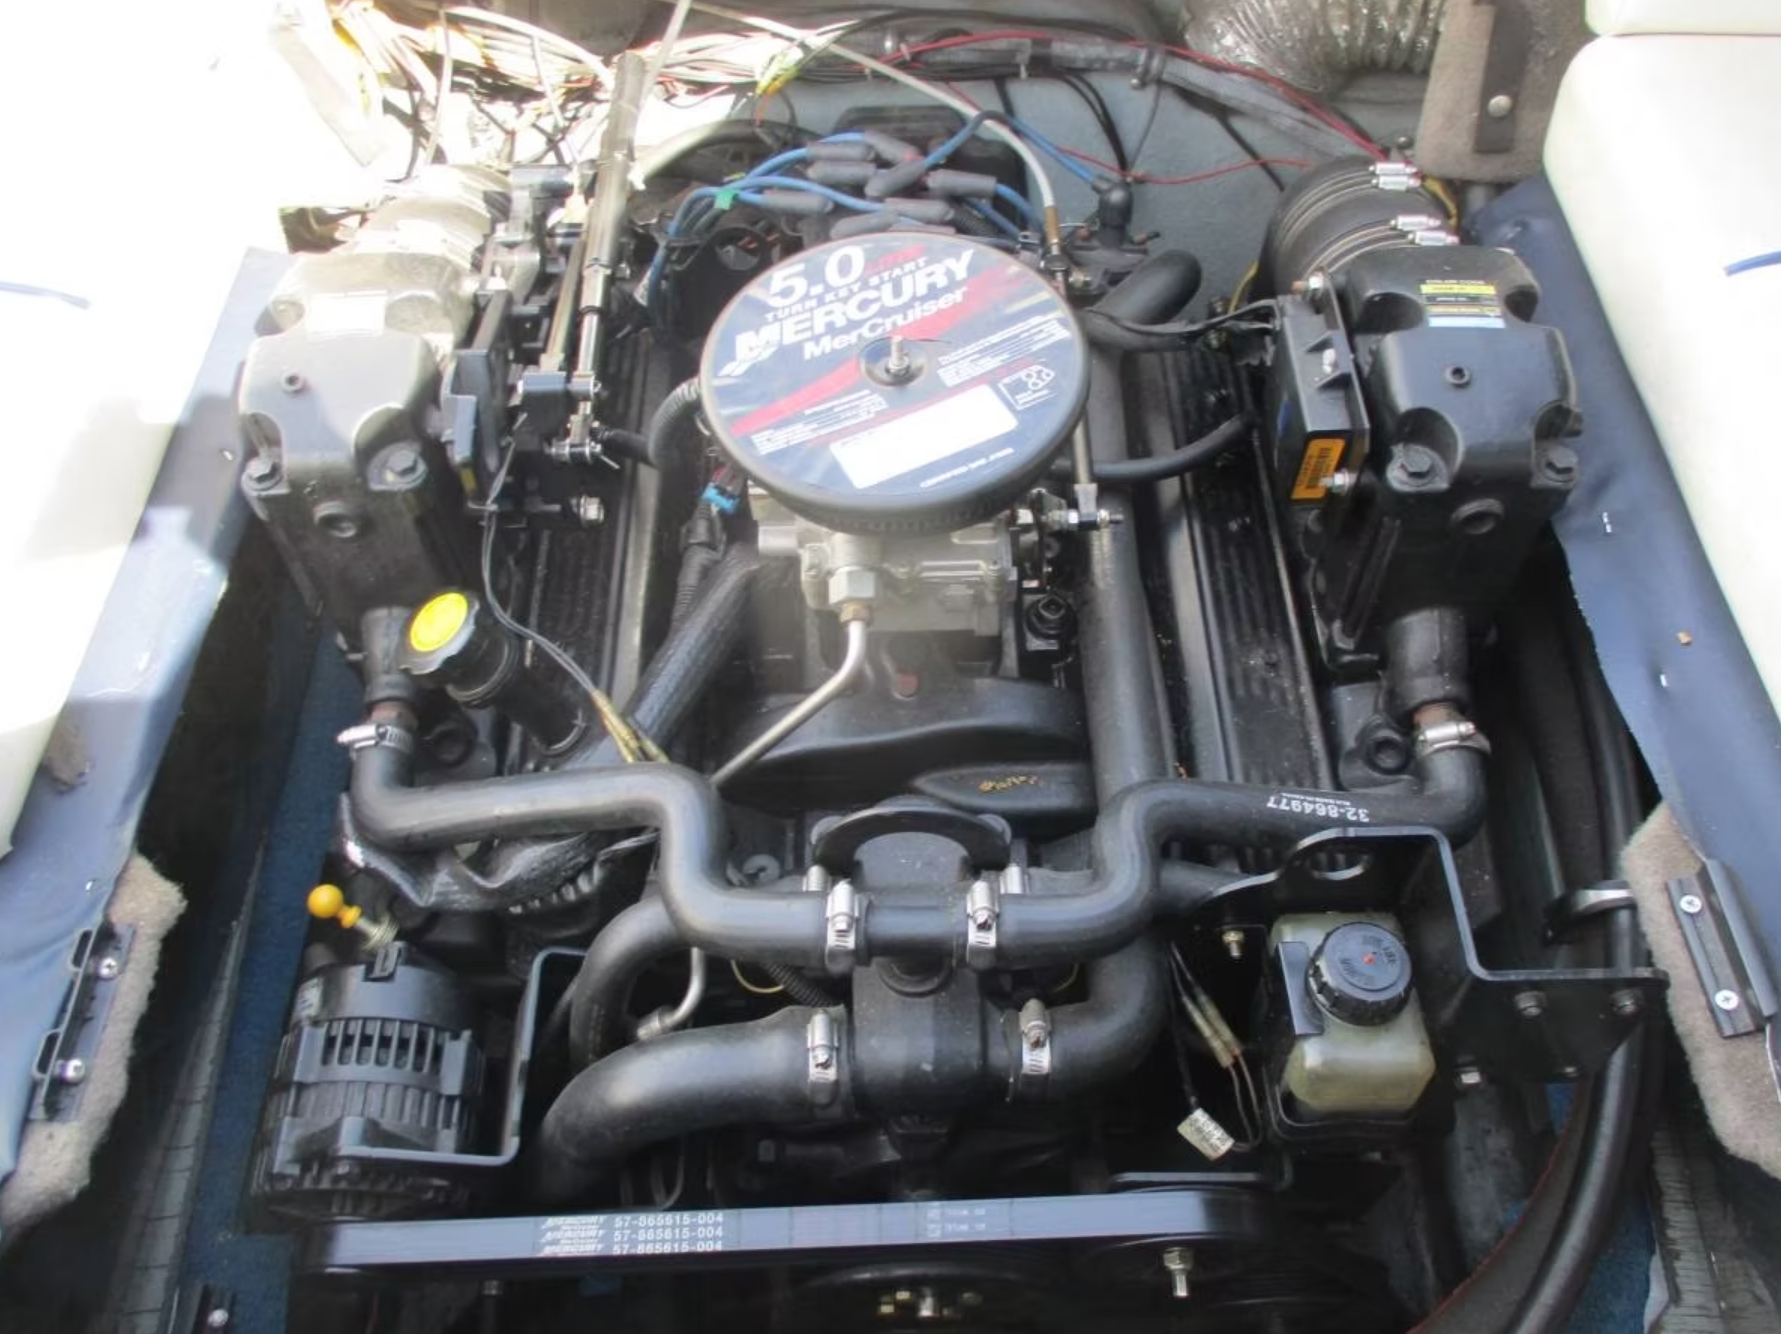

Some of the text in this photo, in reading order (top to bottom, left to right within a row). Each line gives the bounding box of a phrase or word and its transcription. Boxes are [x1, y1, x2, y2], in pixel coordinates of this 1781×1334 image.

[766, 298, 817, 323] TURN
[825, 283, 861, 303] KEY
[868, 256, 929, 286] START
[768, 245, 865, 308] 5.0
[718, 249, 974, 377] MERCURY
[803, 286, 969, 360] MerCruiser
[1266, 795, 1370, 822] 32-864977
